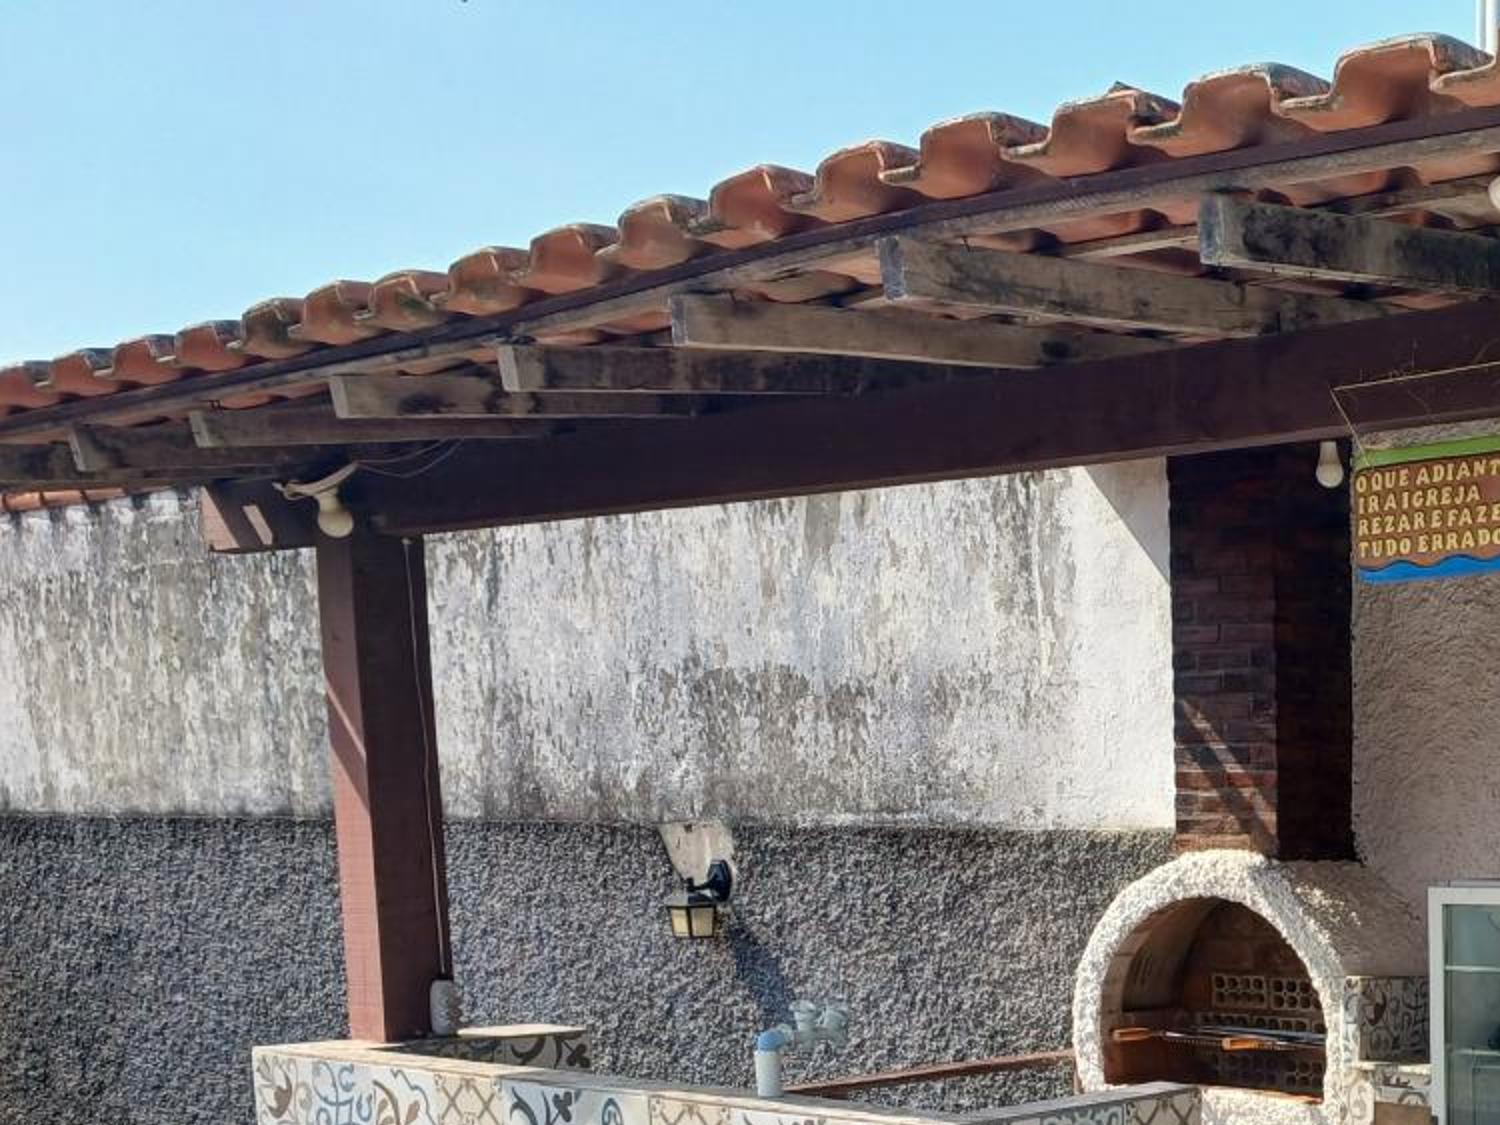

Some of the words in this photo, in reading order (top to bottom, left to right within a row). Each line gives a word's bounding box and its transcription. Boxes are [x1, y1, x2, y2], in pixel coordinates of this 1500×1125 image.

[1355, 475, 1367, 493] O
[1371, 468, 1409, 491] QUE
[1358, 495, 1379, 515] IR
[1383, 493, 1397, 511] A
[1402, 484, 1480, 509] IGREJA
[1358, 512, 1425, 536] REZAR
[1431, 509, 1443, 529] E
[1358, 537, 1411, 558] TUDO
